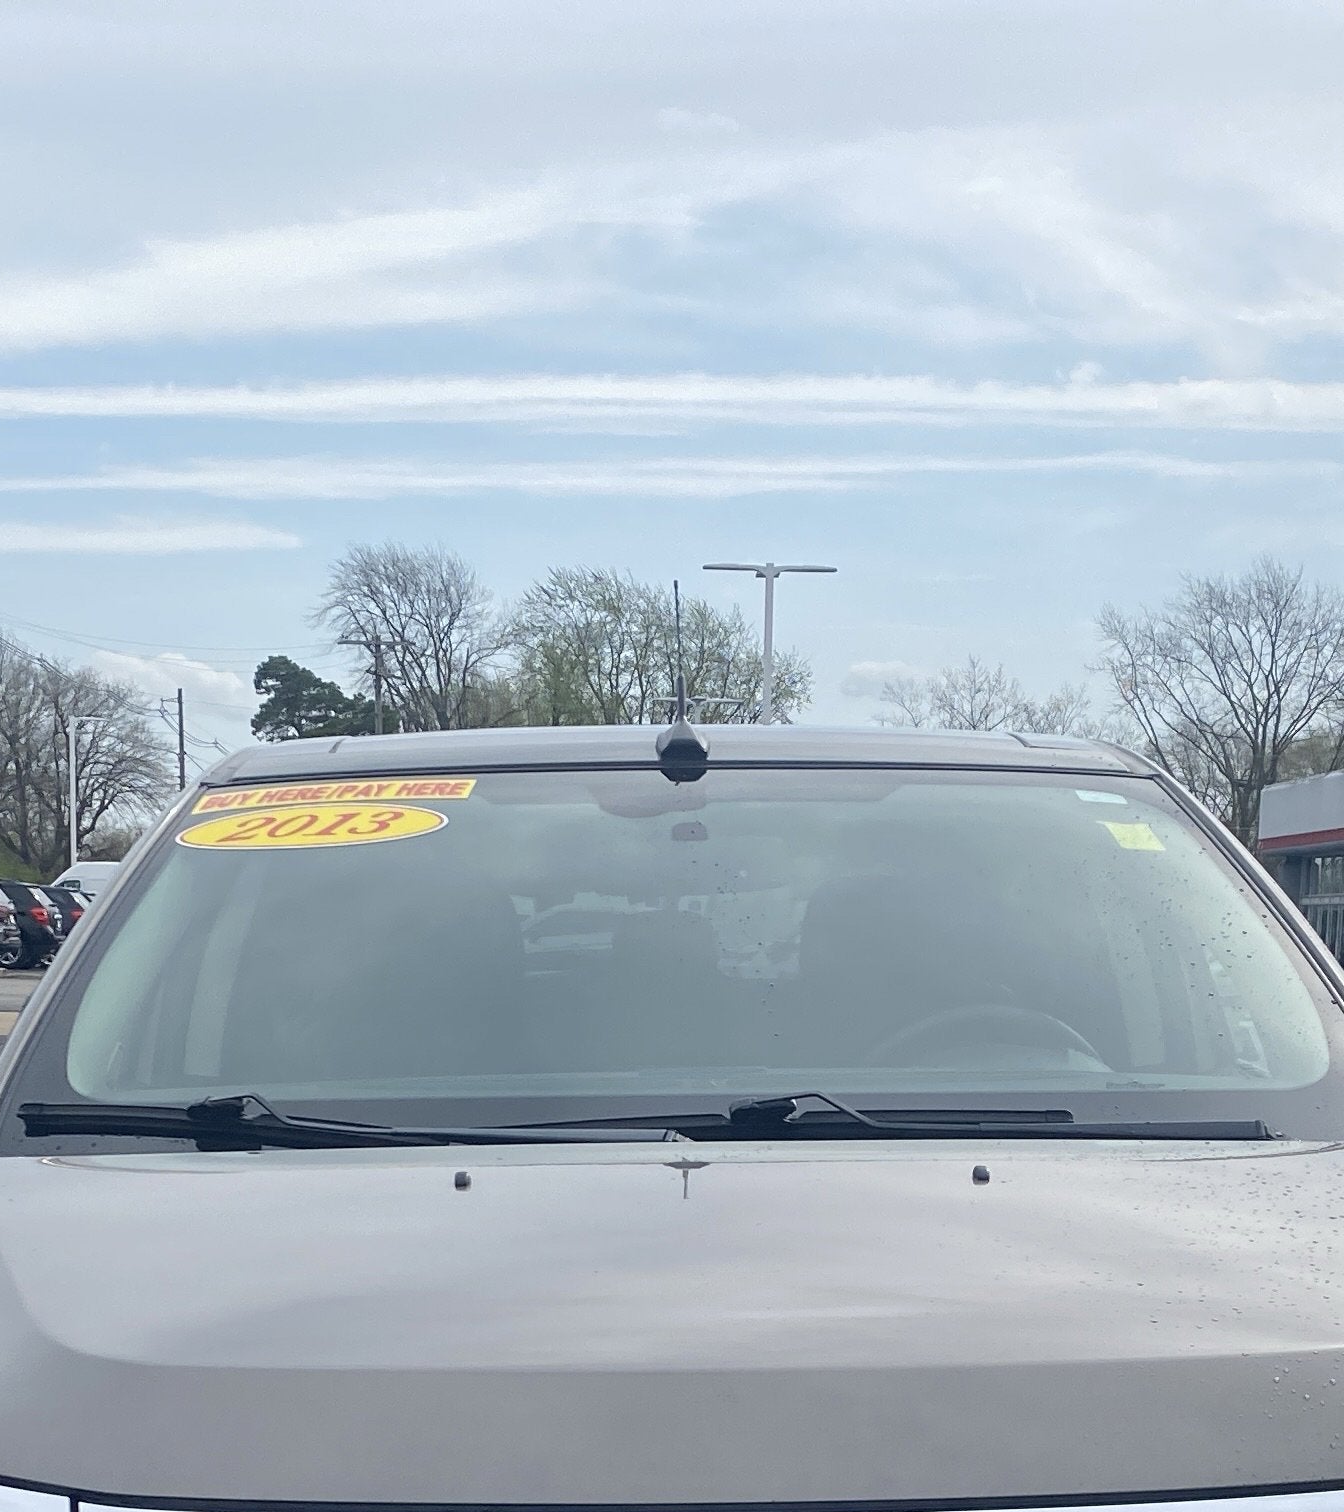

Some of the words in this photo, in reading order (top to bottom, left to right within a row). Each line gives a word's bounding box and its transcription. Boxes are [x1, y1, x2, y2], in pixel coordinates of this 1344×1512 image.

[199, 791, 259, 811] BUY
[257, 783, 395, 804] HERE/PAY
[396, 781, 471, 797] HERE
[215, 811, 405, 842] 2013
